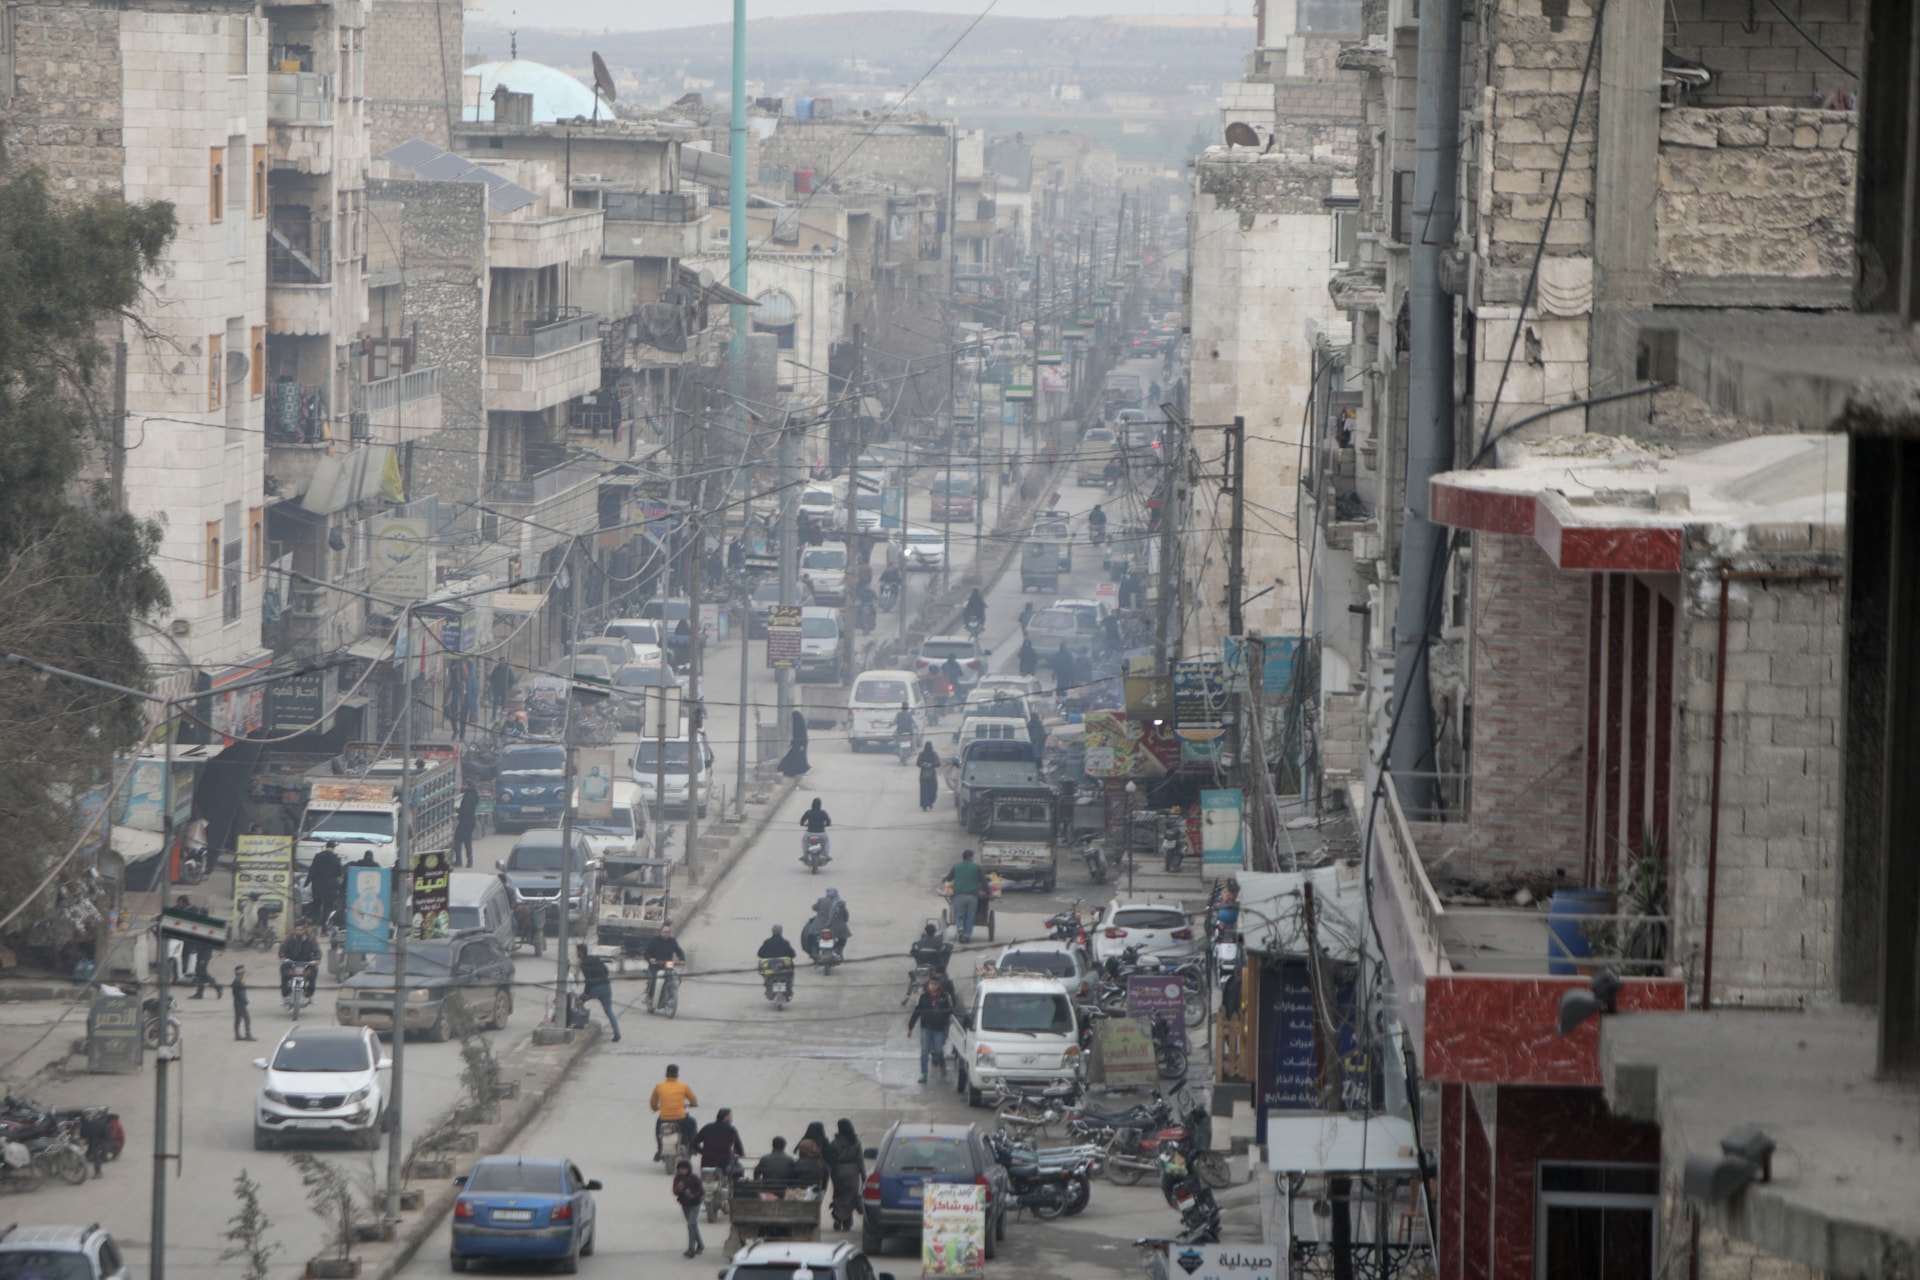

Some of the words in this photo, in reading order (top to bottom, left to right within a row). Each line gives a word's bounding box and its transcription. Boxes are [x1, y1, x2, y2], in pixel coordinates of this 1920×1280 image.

[999, 848, 1035, 856] SONG
[932, 1198, 961, 1213] شاكر
[1219, 1252, 1272, 1271] صيدلية
